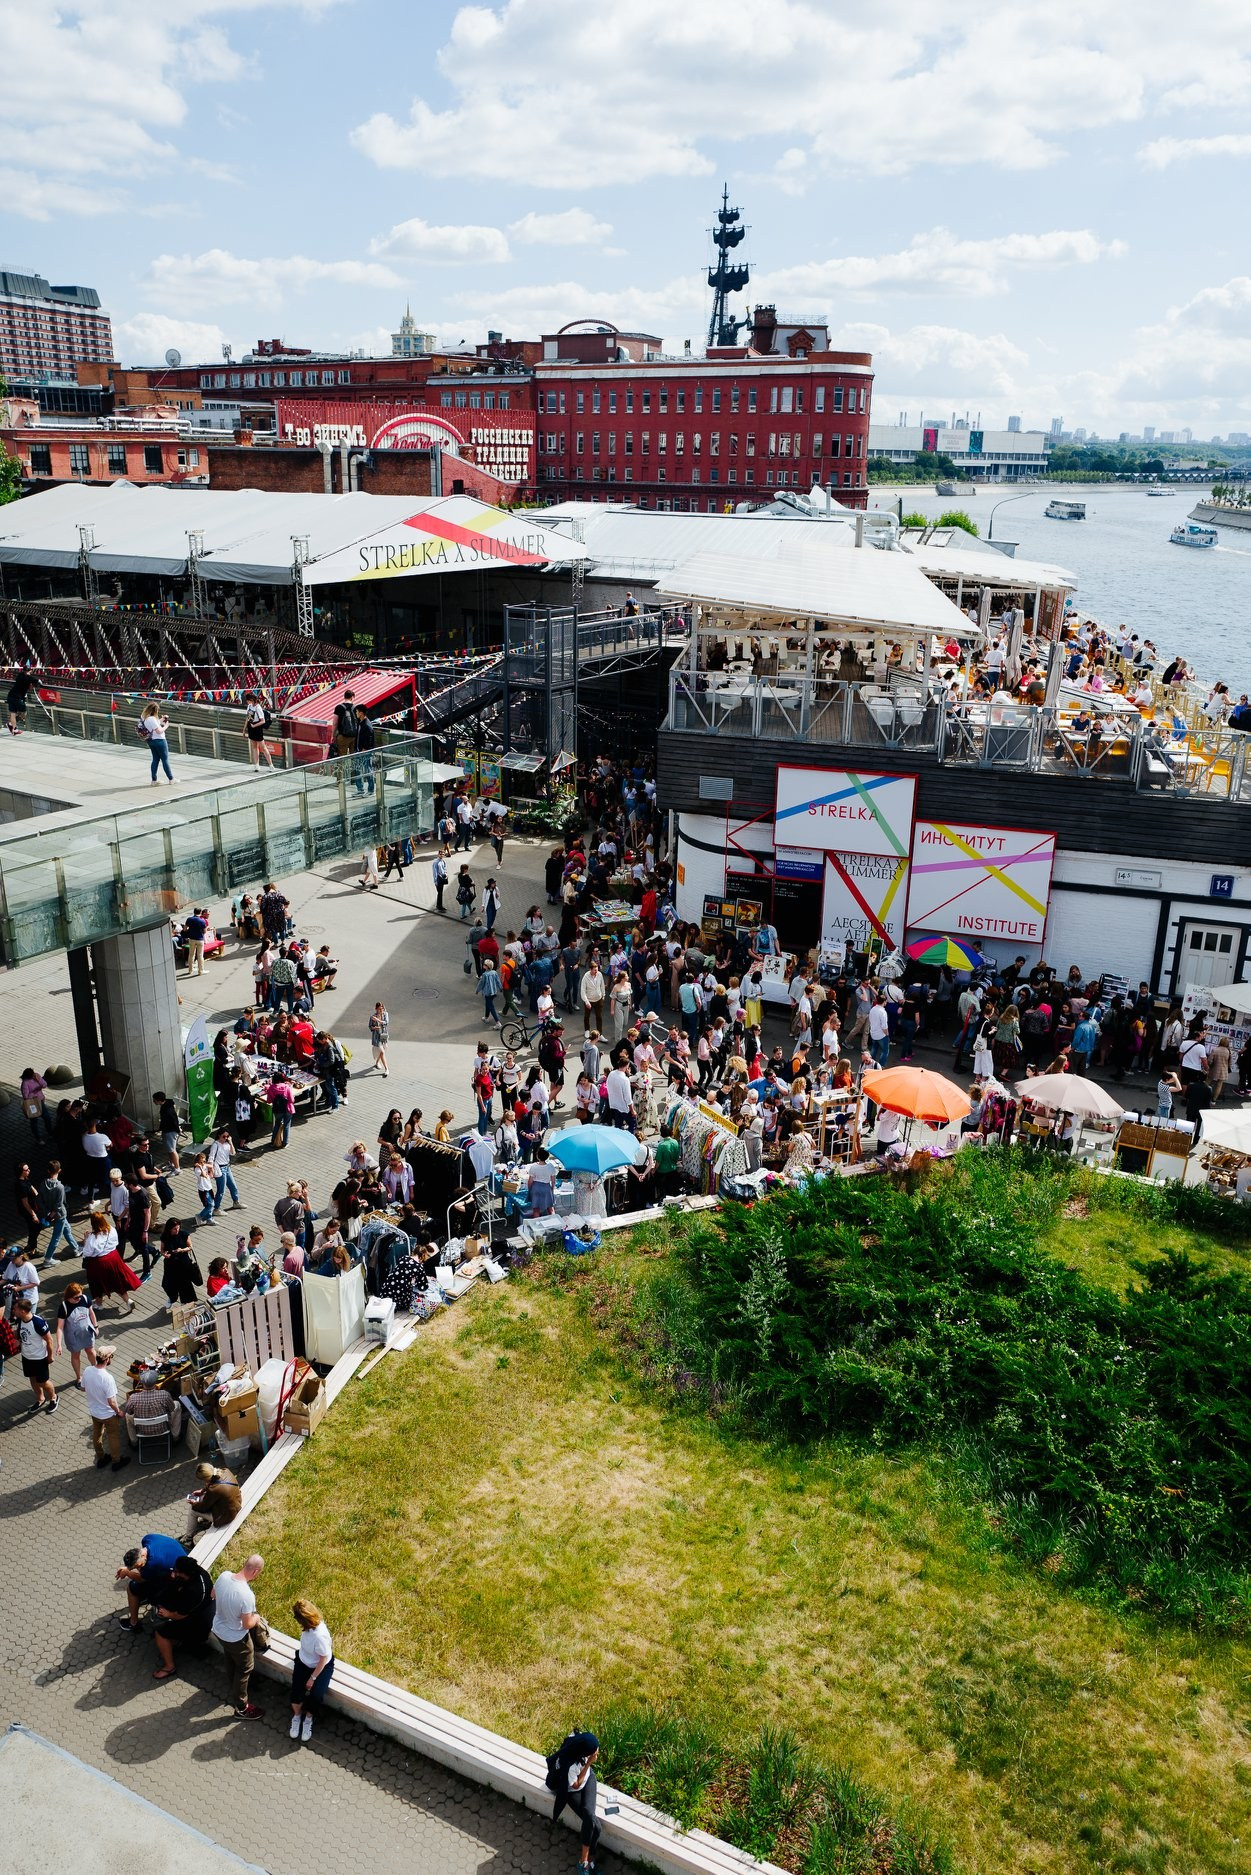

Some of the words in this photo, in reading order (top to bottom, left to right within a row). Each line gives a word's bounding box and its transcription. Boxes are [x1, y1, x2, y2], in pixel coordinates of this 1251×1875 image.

[476, 446, 529, 464] ТРАДИЦИИ
[359, 541, 448, 572] STRELKA
[454, 543, 465, 563] X
[470, 534, 547, 562] SUMMER
[808, 802, 879, 822] STRELKA
[1216, 880, 1229, 891] 14
[957, 915, 1038, 937] INSTITUTE
